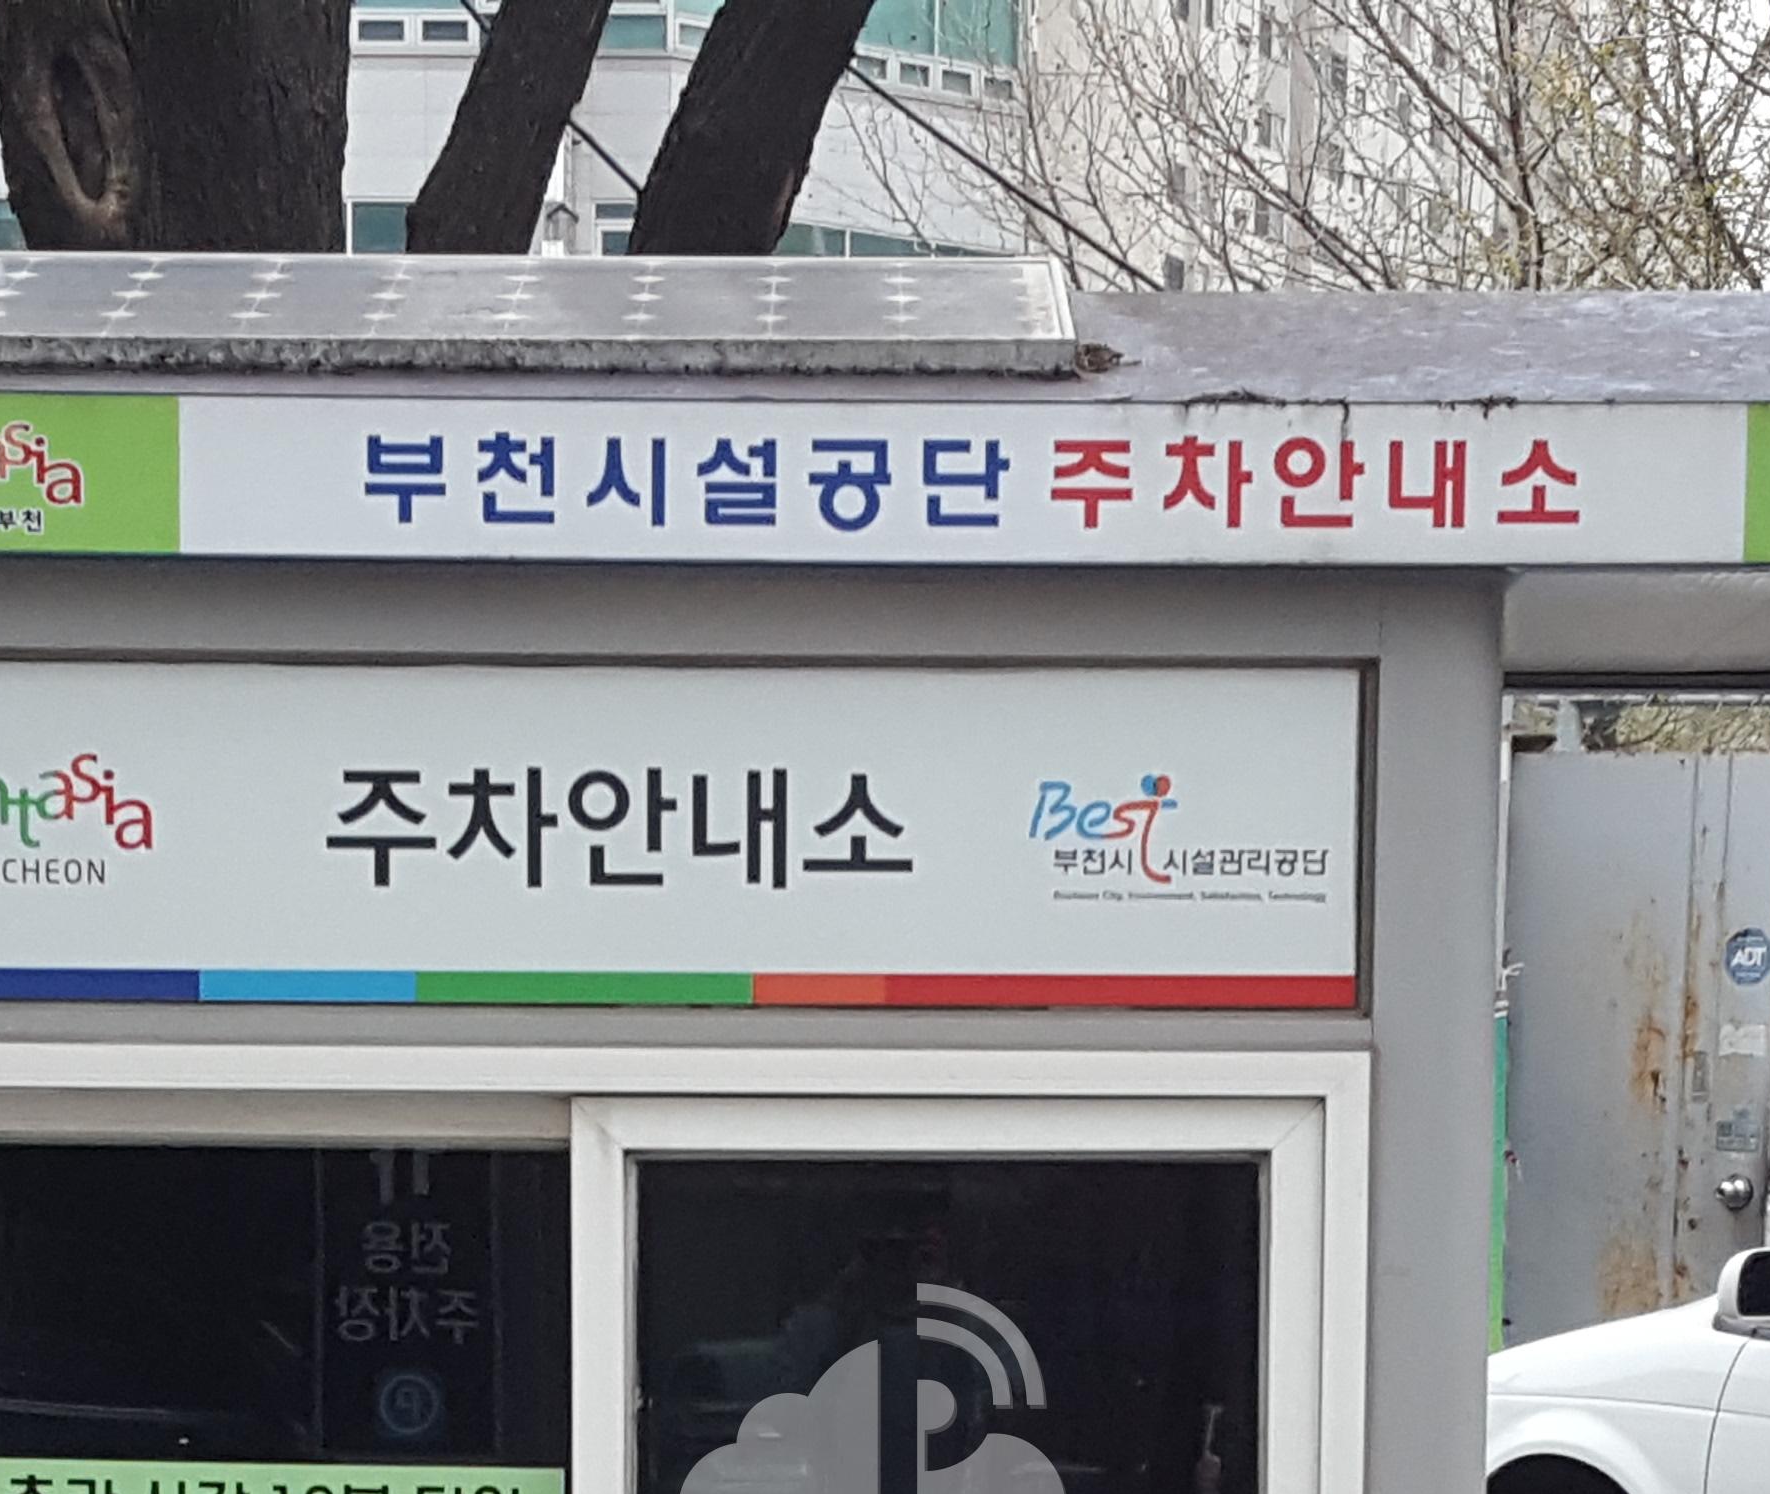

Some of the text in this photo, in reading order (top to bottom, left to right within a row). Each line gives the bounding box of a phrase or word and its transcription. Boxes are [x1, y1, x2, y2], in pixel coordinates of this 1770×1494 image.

[364, 430, 1581, 531] 부천시설공단 주차안내소
[327, 766, 913, 890] 주차안내소
[1029, 780, 1177, 883] Best
[1053, 849, 1328, 876] 부천시 시설관리공단
[1730, 946, 1767, 969] ADT
